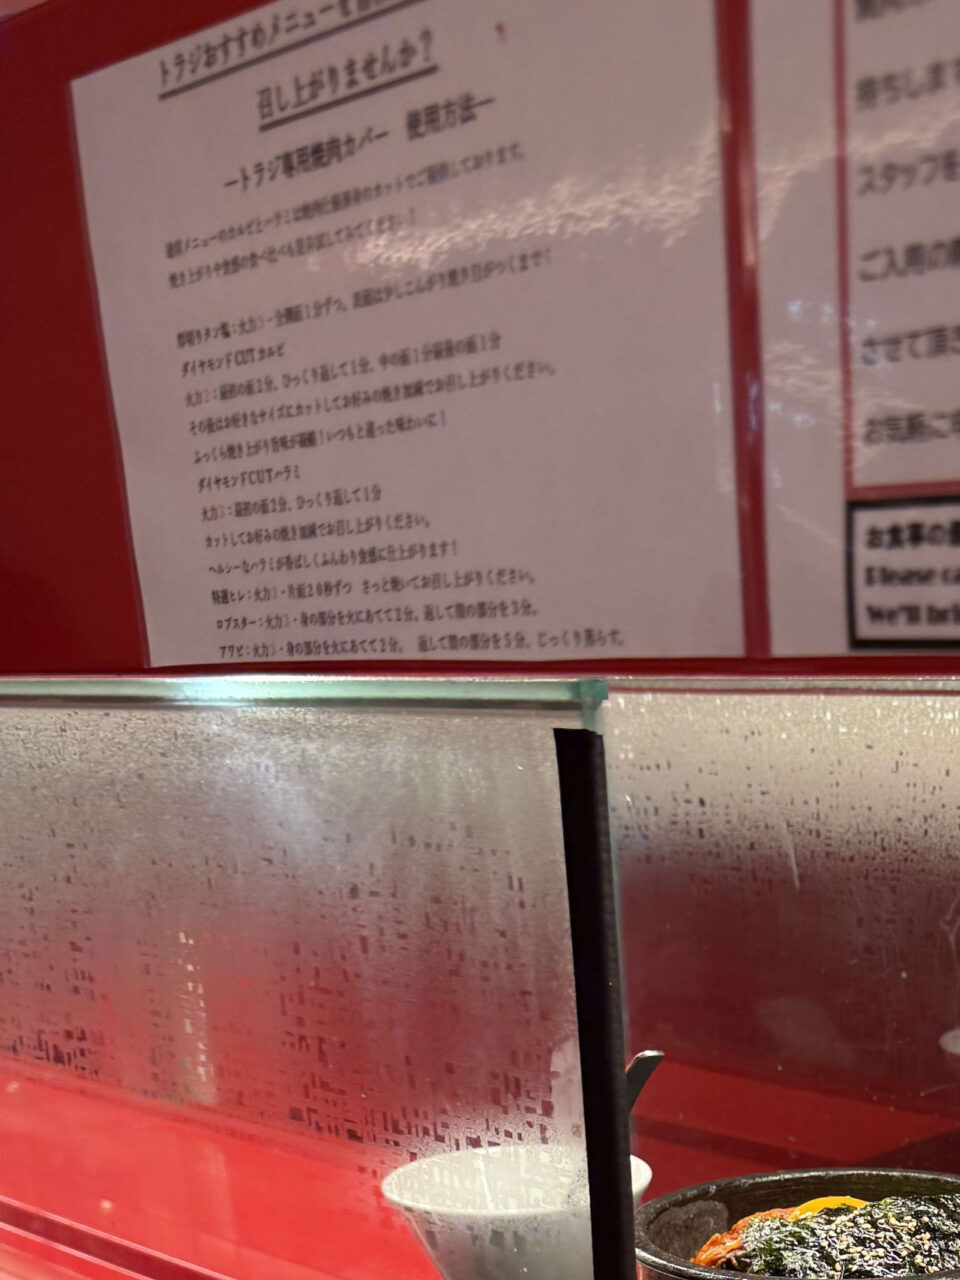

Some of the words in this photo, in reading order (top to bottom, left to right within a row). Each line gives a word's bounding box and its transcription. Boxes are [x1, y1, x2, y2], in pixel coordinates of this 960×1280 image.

[258, 30, 434, 120] 召し上がりませんか？
